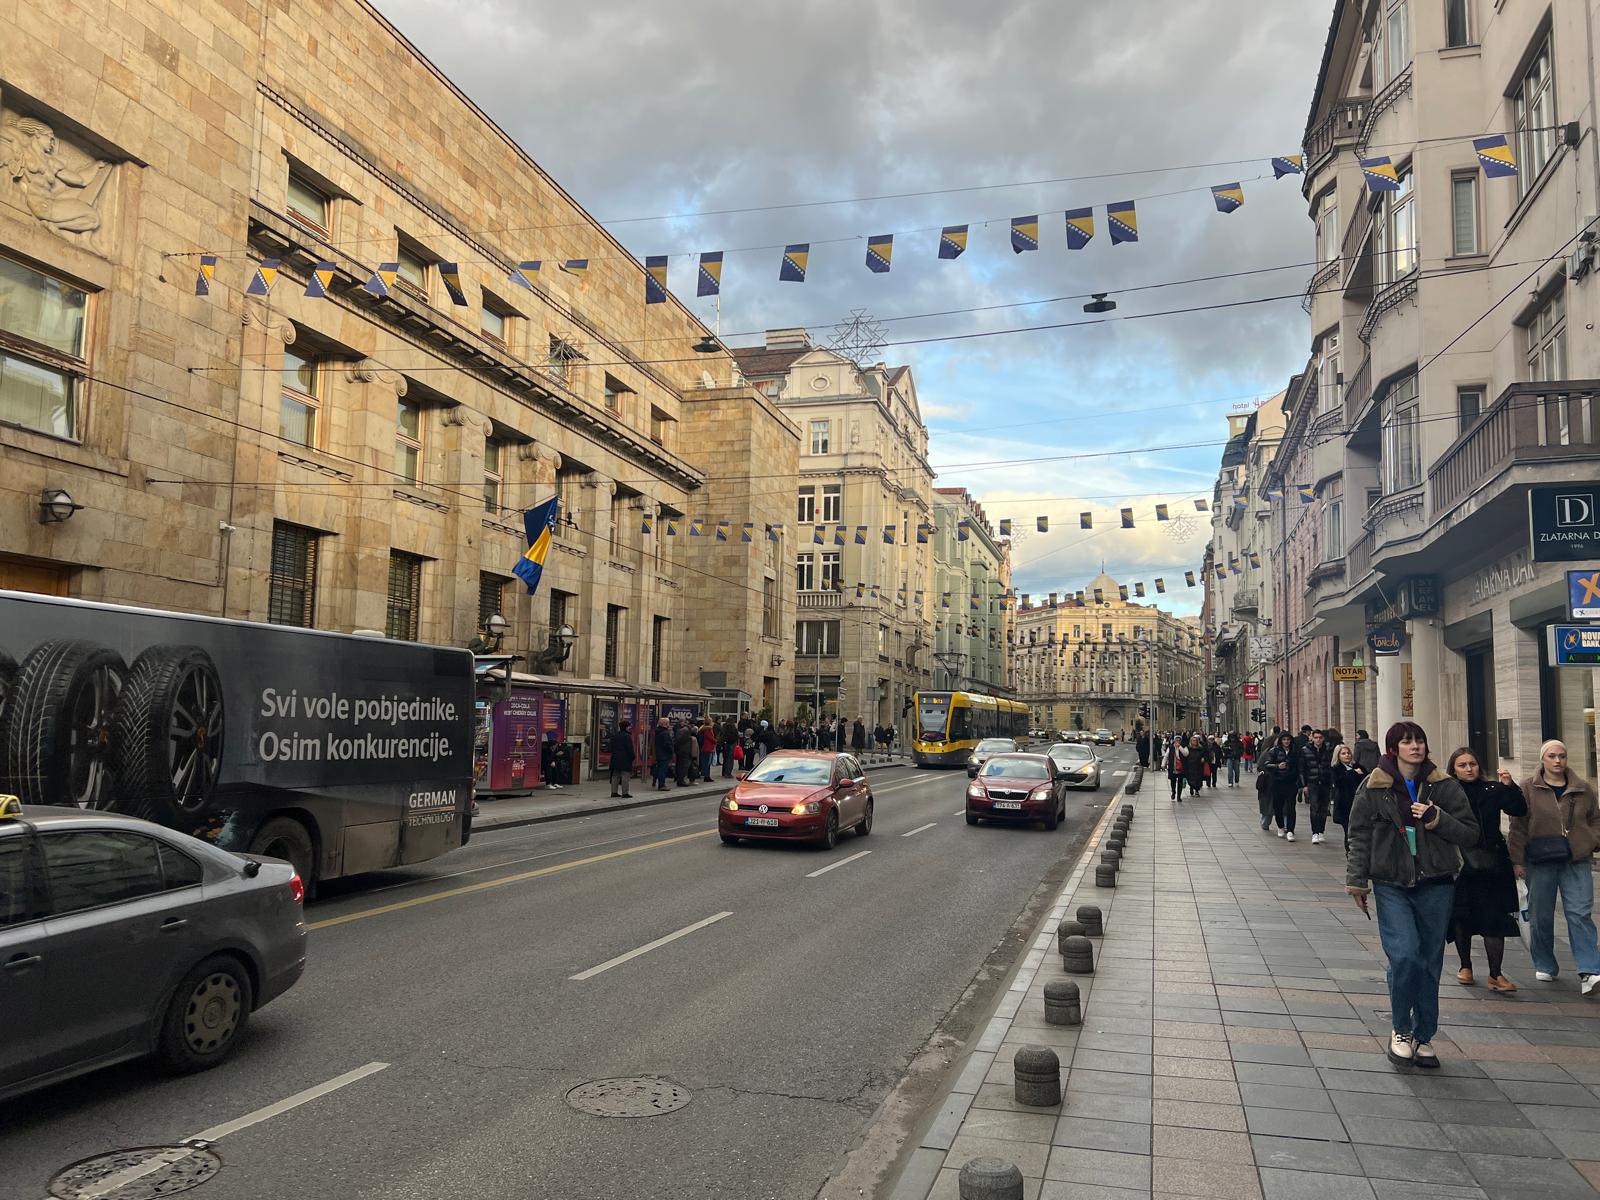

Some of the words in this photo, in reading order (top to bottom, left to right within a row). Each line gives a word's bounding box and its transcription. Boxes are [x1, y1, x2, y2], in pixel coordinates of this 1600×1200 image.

[1558, 498, 1589, 524] D
[1540, 532, 1590, 541] ZLATARNA
[1335, 667, 1363, 675] NOTAR
[260, 687, 297, 718] Svi
[303, 692, 349, 720] vole
[354, 695, 459, 726] pobjednike.
[259, 731, 320, 762] Osim
[327, 731, 453, 762] konkurencije.
[408, 789, 456, 808] GERMAN
